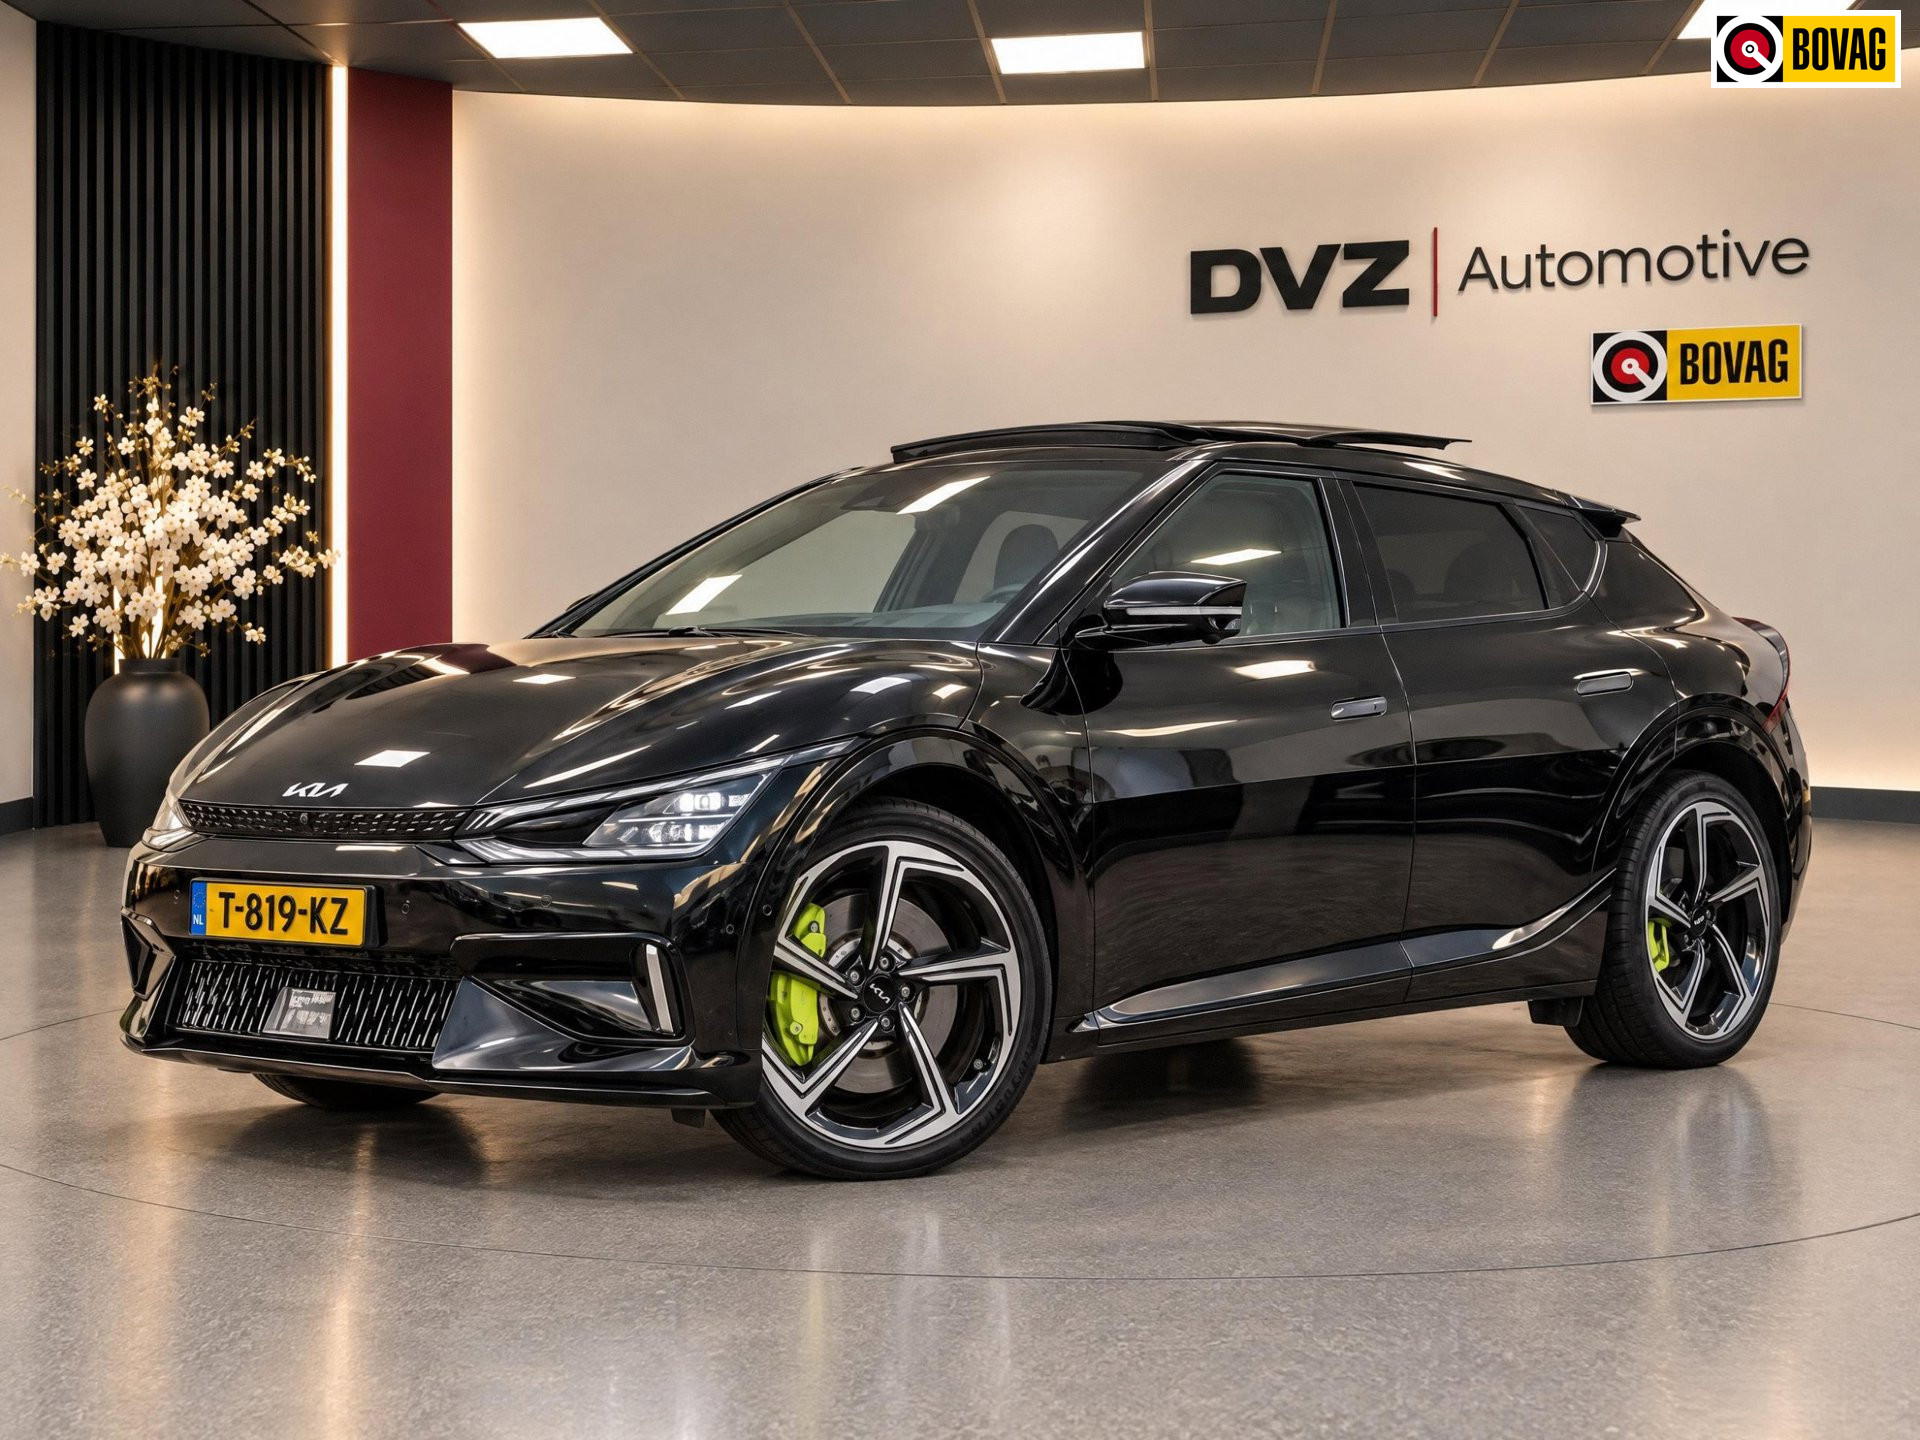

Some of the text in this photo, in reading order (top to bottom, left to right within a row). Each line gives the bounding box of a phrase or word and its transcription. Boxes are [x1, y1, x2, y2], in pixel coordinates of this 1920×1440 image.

[1190, 229, 1810, 314] DVZ Automotive
[1679, 338, 1788, 386] BOVAG
[282, 782, 349, 798] KIA
[193, 914, 204, 926] NL
[218, 891, 349, 936] T-819-KZ
